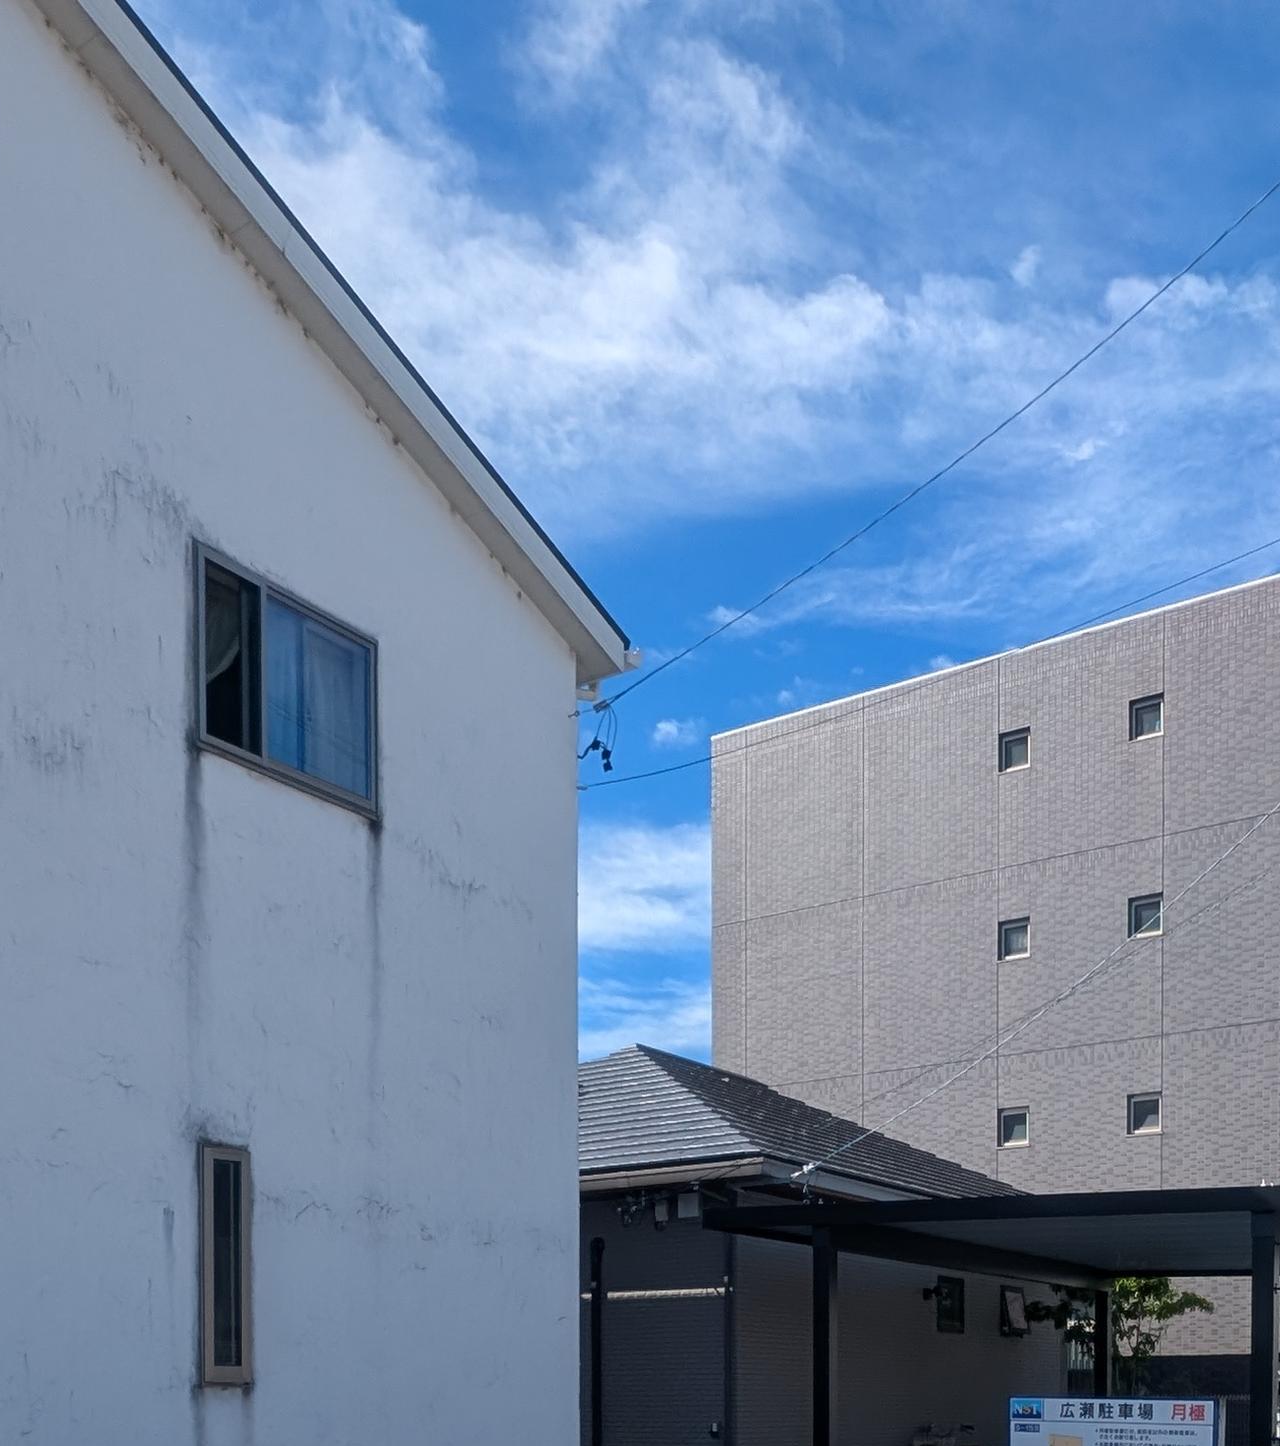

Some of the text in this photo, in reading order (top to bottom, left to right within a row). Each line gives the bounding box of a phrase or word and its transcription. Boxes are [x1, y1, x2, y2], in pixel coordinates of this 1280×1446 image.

[1060, 1402, 1206, 1421] 広瀬駐車場 月極
